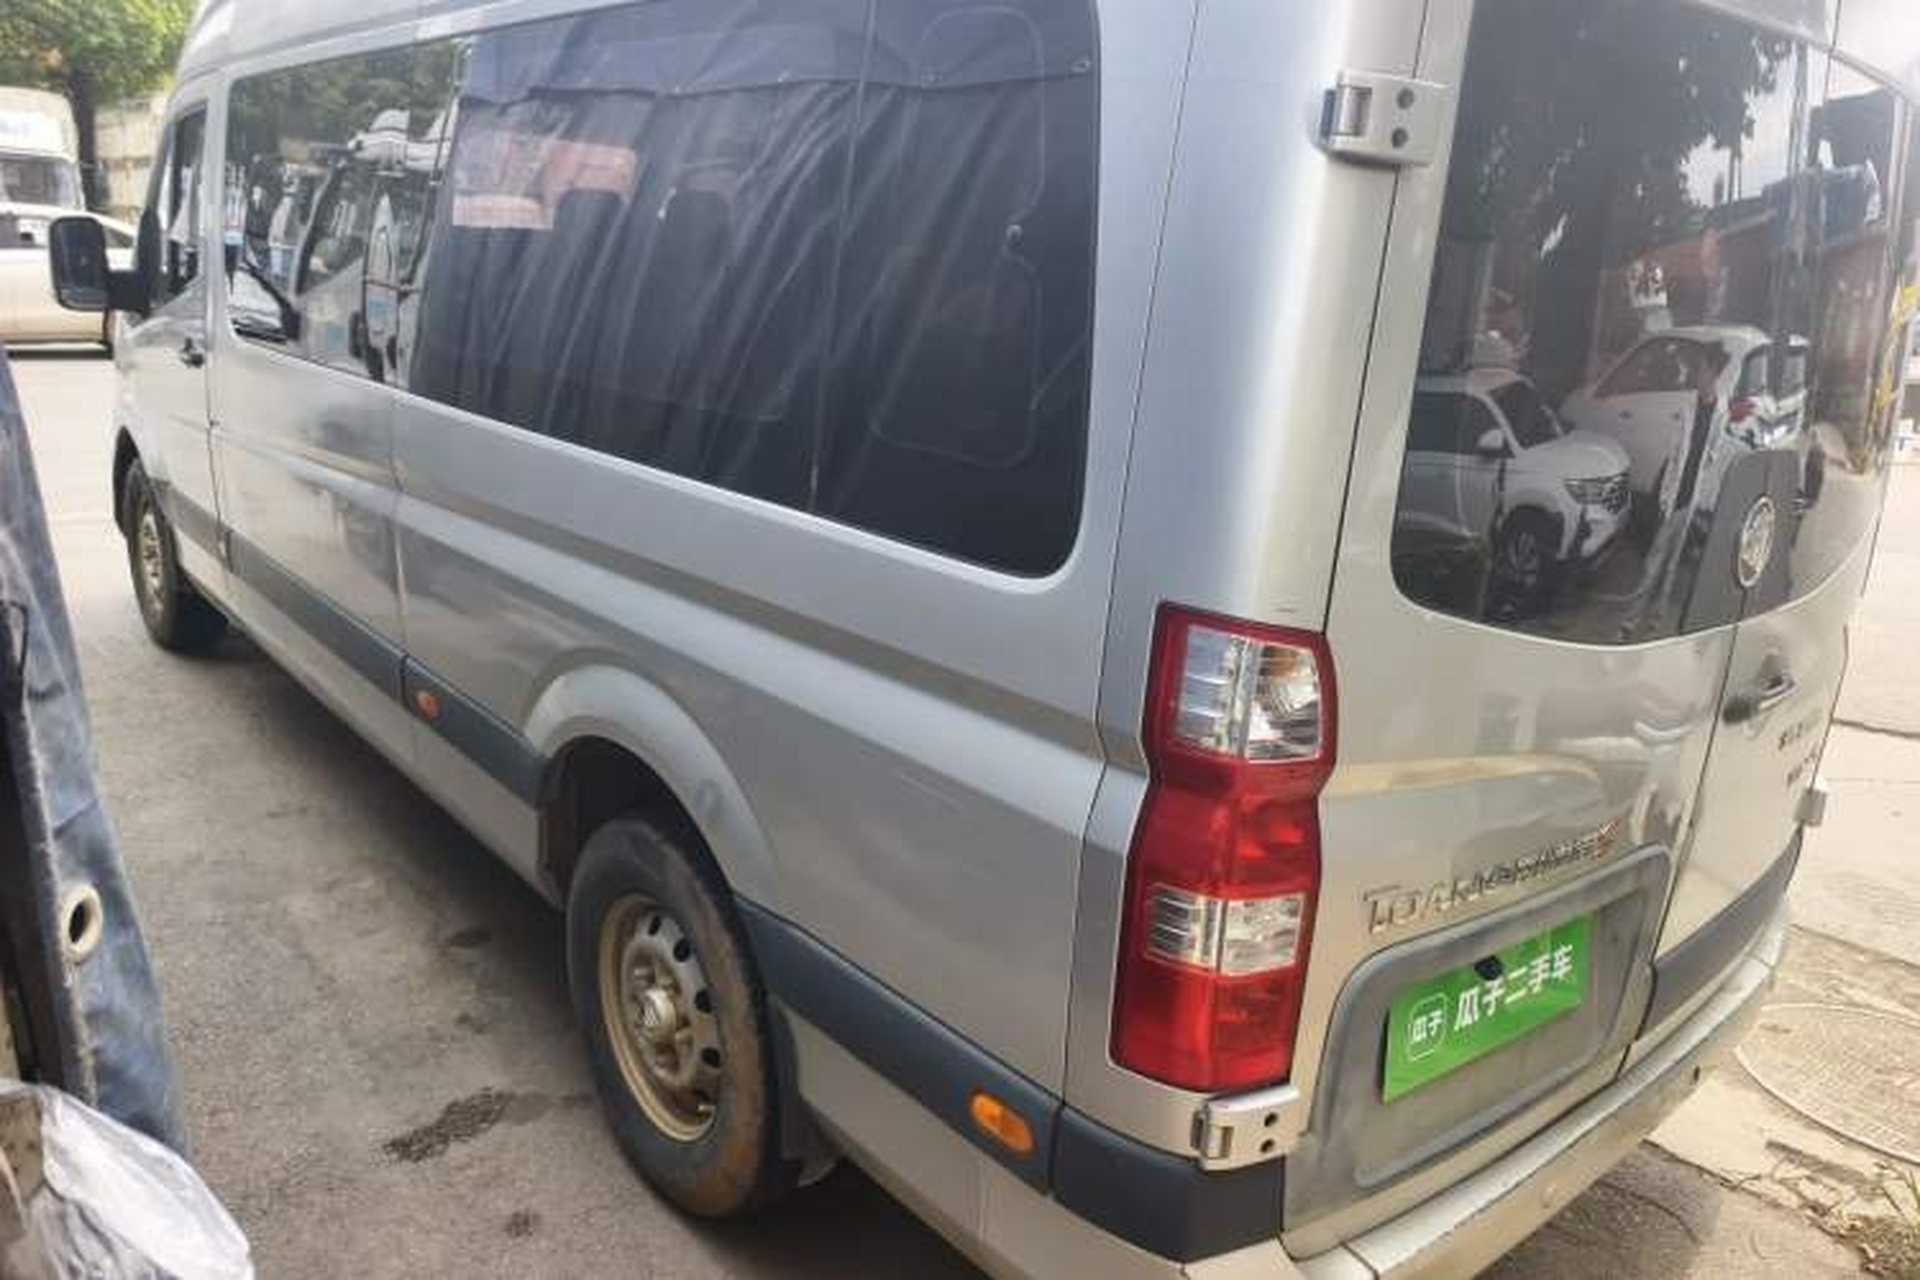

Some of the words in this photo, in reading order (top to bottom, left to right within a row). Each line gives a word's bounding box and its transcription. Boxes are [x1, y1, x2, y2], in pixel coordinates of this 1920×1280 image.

[1454, 944, 1573, 1031] 瓜子二手车
[1411, 1009, 1443, 1042] 瓜子
